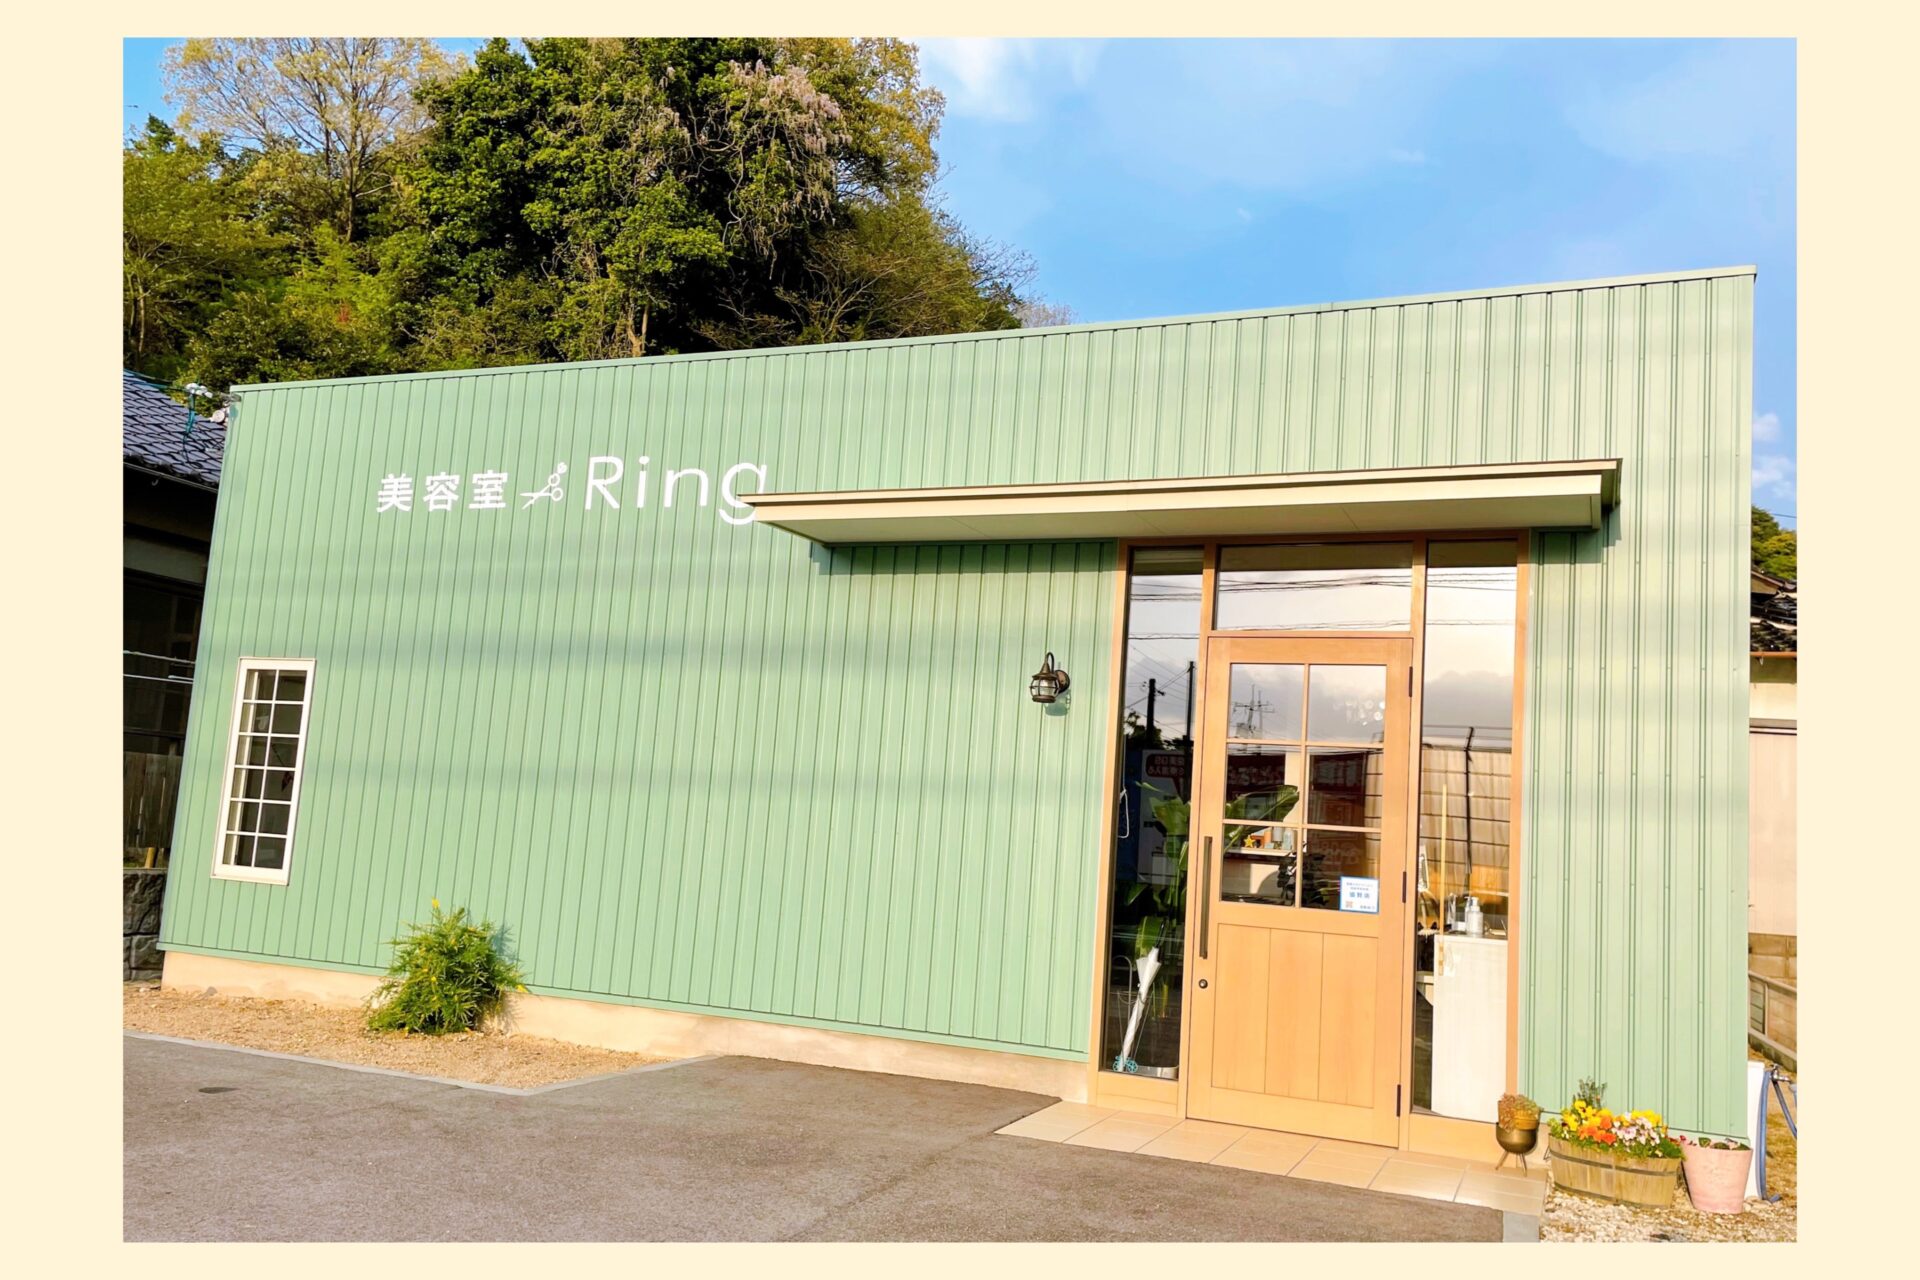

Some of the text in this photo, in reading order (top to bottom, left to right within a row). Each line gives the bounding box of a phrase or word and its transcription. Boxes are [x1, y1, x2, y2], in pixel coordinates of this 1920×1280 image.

[376, 455, 767, 525] 美容室 Ring
